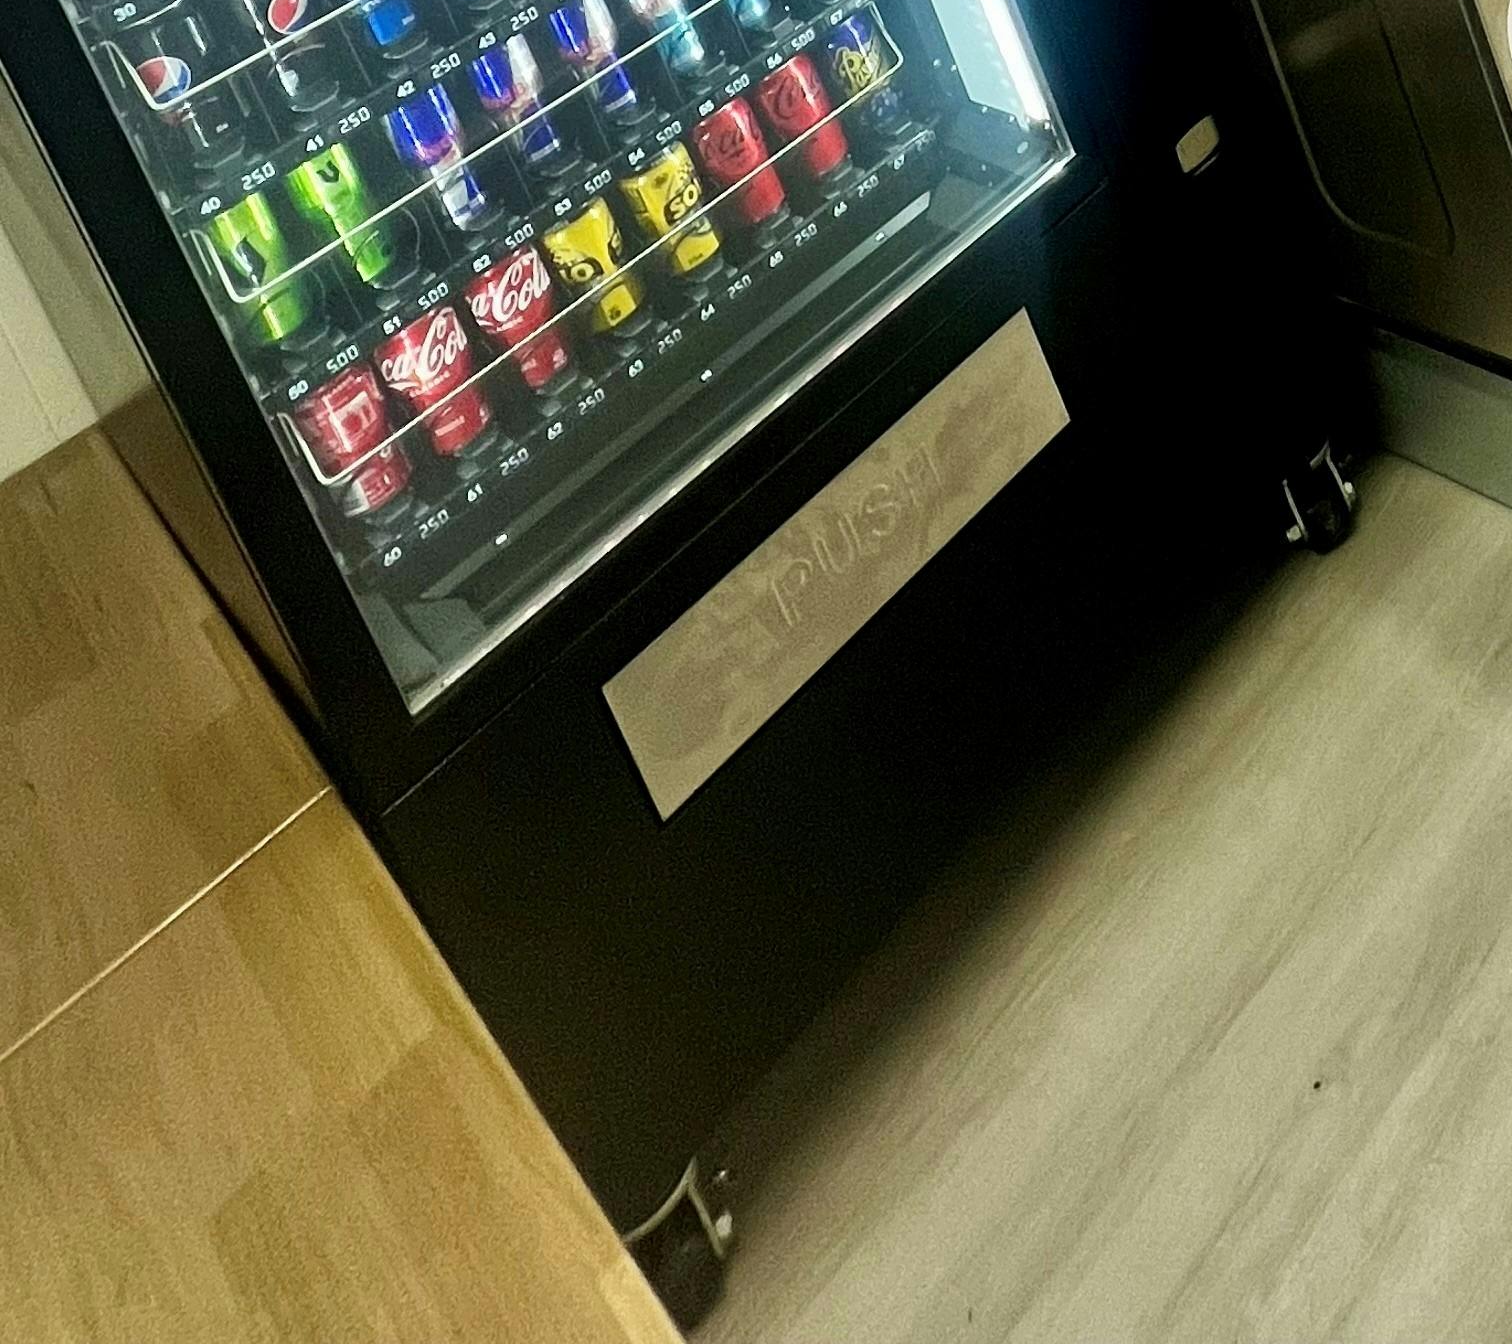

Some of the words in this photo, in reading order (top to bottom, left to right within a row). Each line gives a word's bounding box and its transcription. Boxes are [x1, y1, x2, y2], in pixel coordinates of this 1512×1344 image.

[113, 2, 137, 22] 30
[478, 31, 497, 50] 43
[395, 79, 417, 98] 42
[304, 134, 325, 153] 41
[199, 196, 222, 216] 40
[832, 200, 848, 218] 66
[768, 251, 784, 269] 65
[698, 303, 716, 322] 64
[627, 359, 645, 378] 63
[545, 421, 563, 441] 62
[466, 483, 485, 503] 61
[768, 443, 945, 630] PUSH
[383, 545, 402, 568] 60
